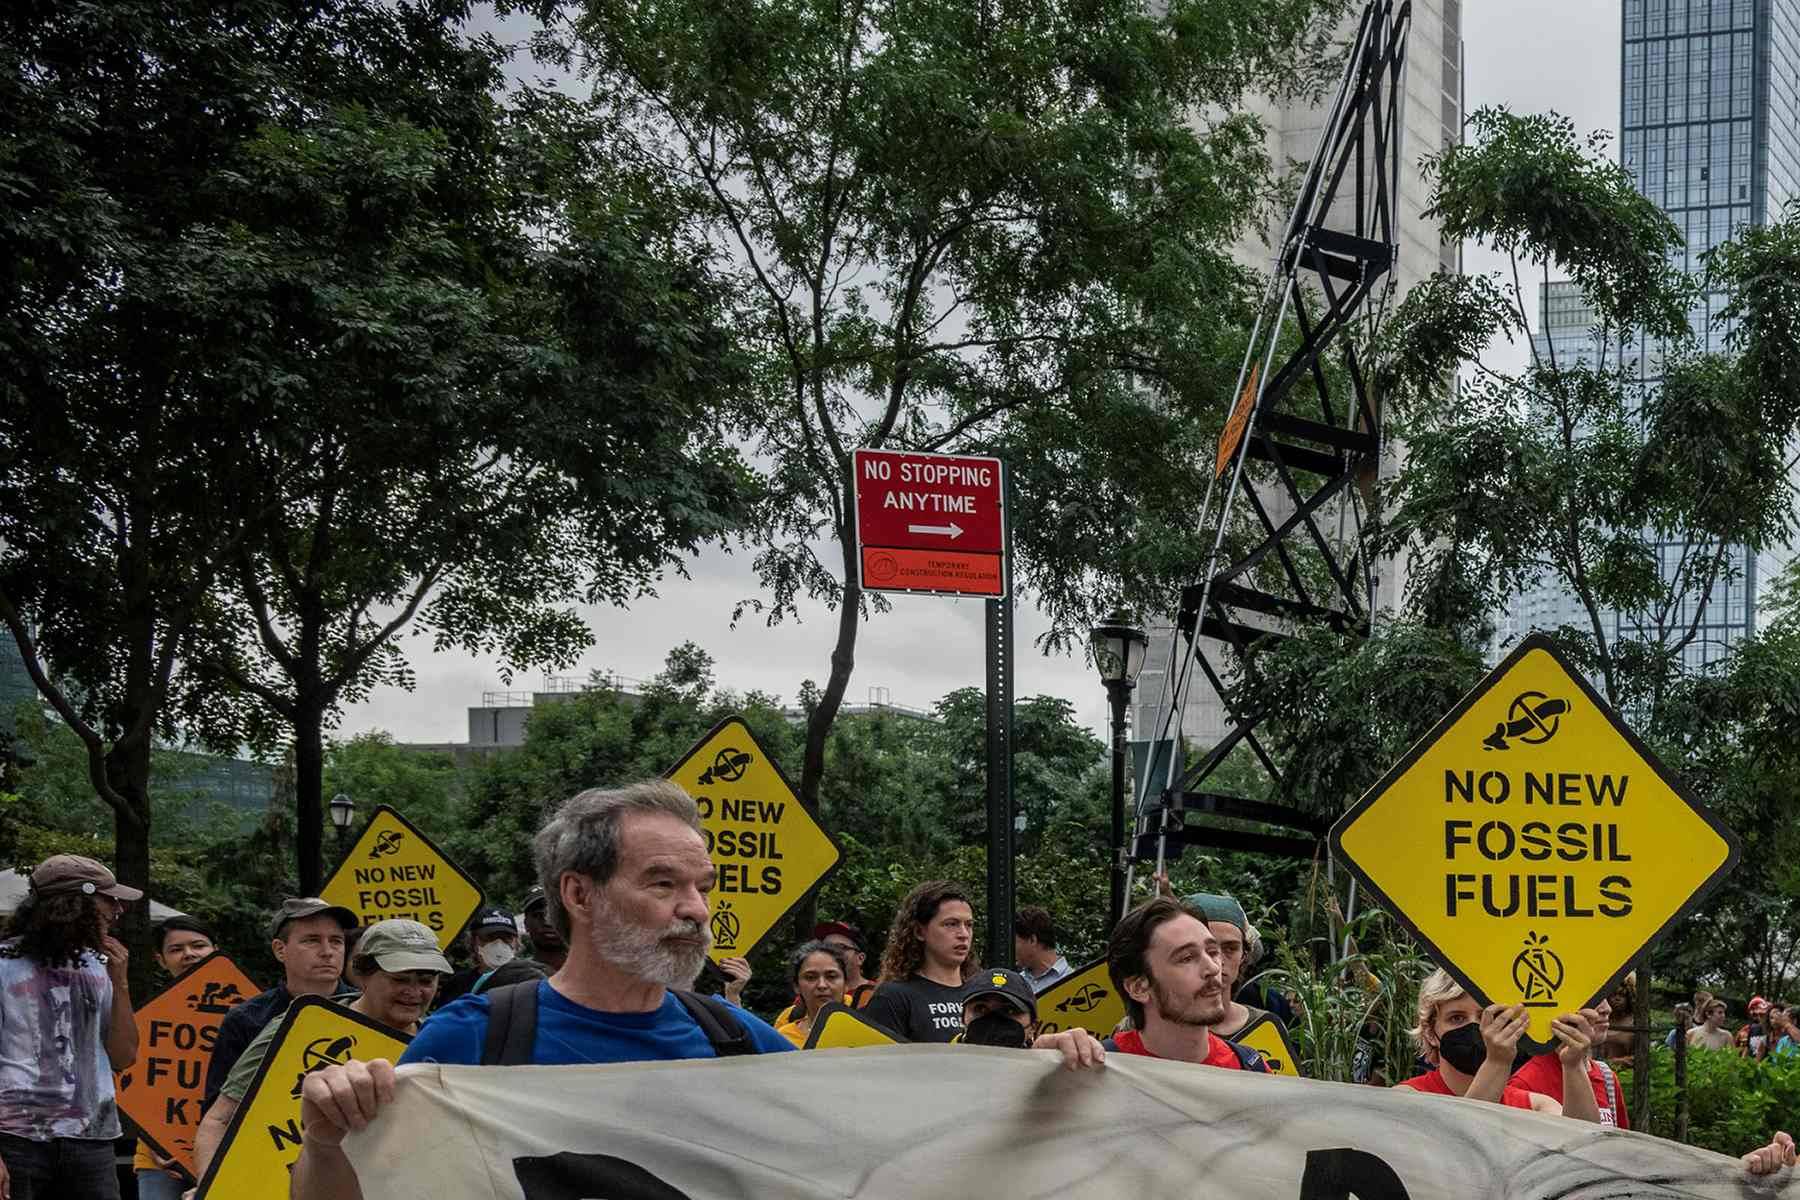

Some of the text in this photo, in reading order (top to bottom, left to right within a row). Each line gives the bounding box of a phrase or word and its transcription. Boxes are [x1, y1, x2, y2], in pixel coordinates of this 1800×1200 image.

[864, 459, 992, 487] NO STOPPING
[883, 490, 977, 514] ANYTIME
[1445, 769, 1629, 807] NO NEW
[696, 796, 785, 825] O NEW
[701, 828, 784, 860] OSSIL
[1445, 820, 1632, 862] FOSSIL
[354, 863, 436, 885] NO NEW
[713, 863, 783, 895] ELS
[358, 887, 442, 910] FOSSIL
[1446, 873, 1633, 918] FUELS
[148, 1020, 220, 1053] FOS
[932, 1016, 961, 1029] TOG
[146, 1056, 202, 1090] FU
[267, 1118, 305, 1152] N
